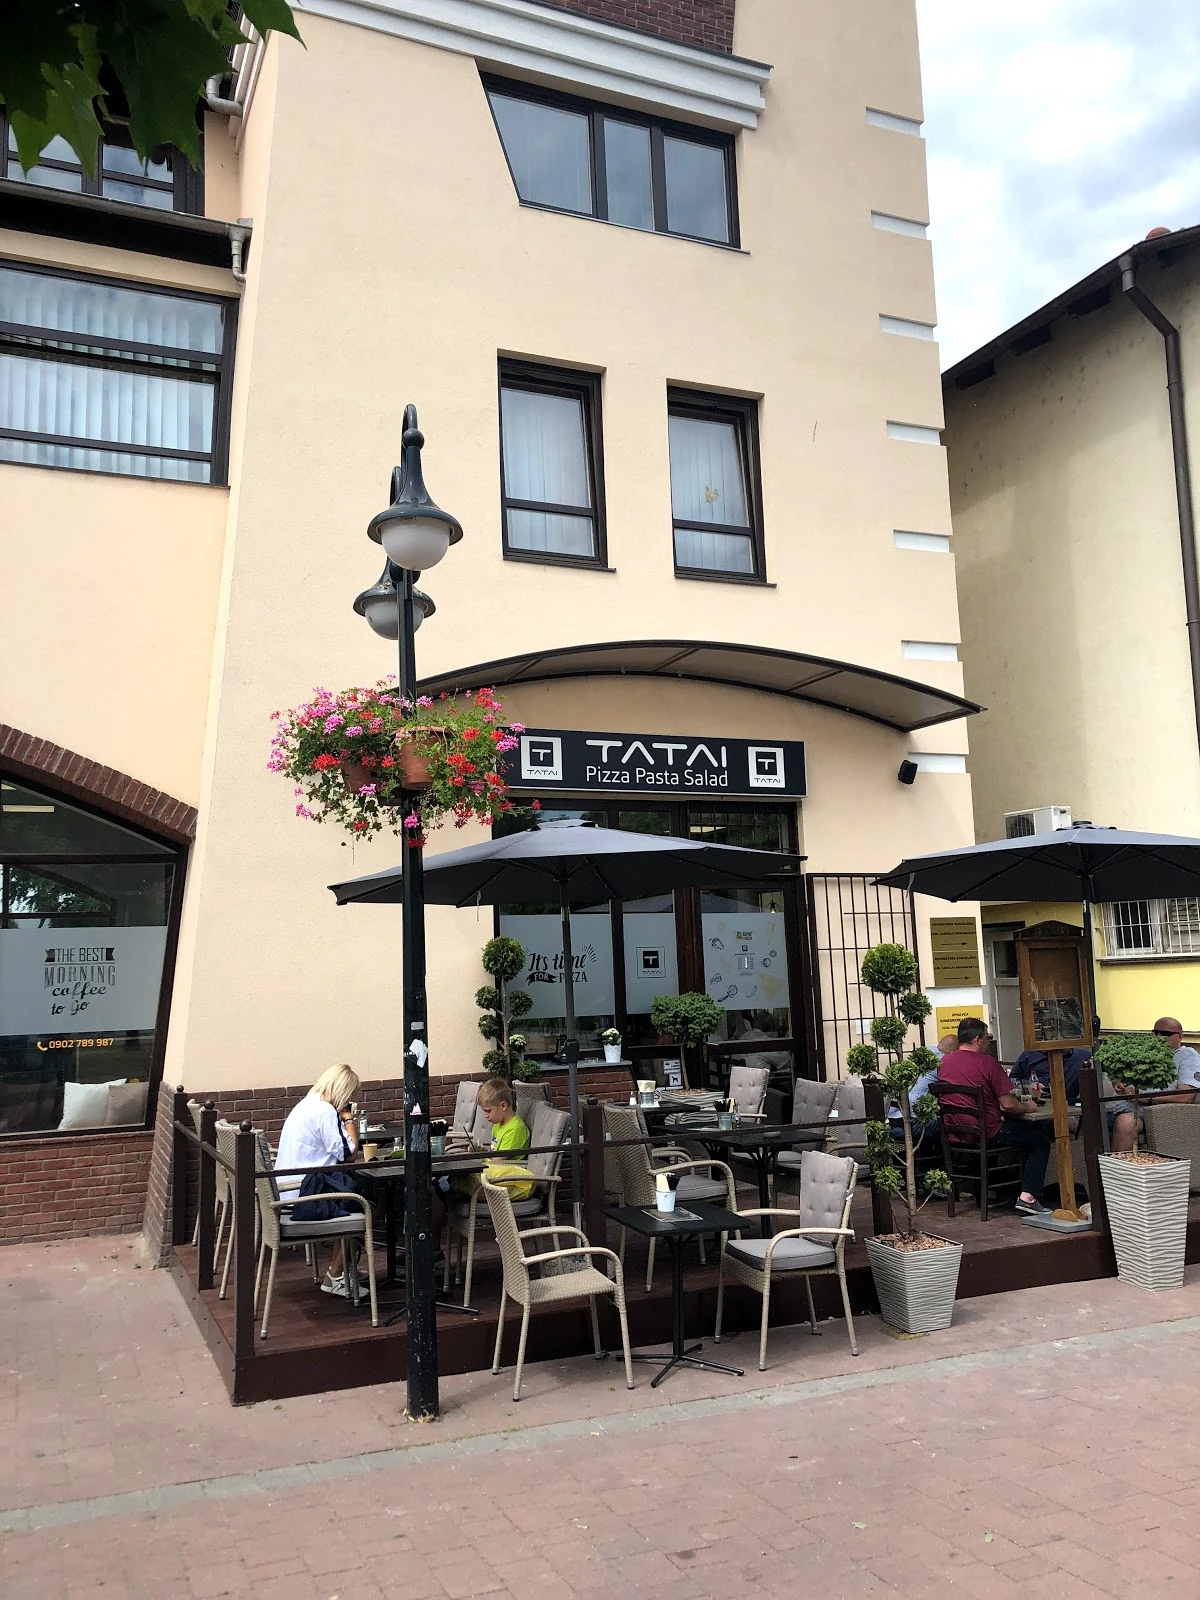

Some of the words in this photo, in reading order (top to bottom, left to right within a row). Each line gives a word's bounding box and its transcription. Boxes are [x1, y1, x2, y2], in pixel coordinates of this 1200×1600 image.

[586, 740, 727, 768] TATAI
[586, 765, 630, 784] Pizza
[635, 768, 679, 785] Pasta
[684, 769, 728, 787] Salad
[55, 948, 75, 962] THE
[79, 947, 106, 961] BEST
[528, 953, 548, 971] It's
[44, 965, 115, 989] MORNING
[534, 973, 549, 981] FOR
[52, 982, 107, 999] coffee
[51, 1003, 66, 1015] to
[48, 1040, 74, 1049] 0902
[76, 1039, 94, 1048] 789
[96, 1038, 114, 1047] 987
